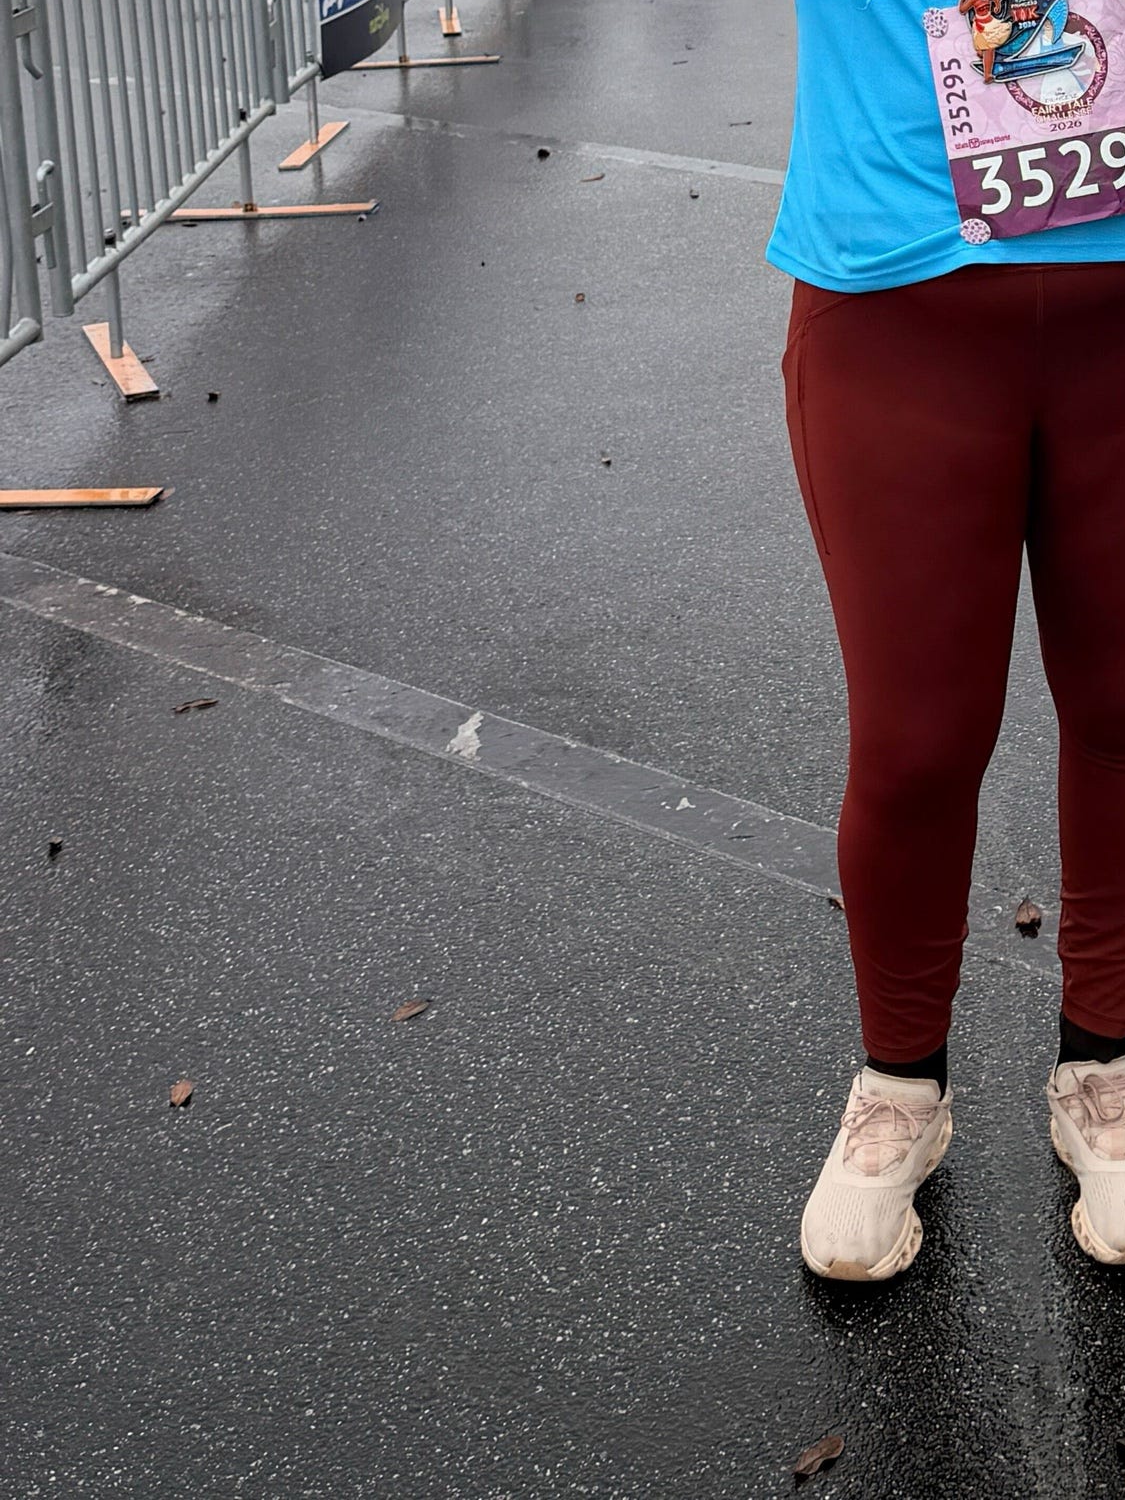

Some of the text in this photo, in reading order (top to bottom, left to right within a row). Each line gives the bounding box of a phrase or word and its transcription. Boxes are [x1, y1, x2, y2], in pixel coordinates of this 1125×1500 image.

[1012, 5, 1040, 21] 10K
[941, 58, 973, 136] 35295
[1031, 96, 1095, 117] FAIRY TALE
[1049, 119, 1083, 133] 2026
